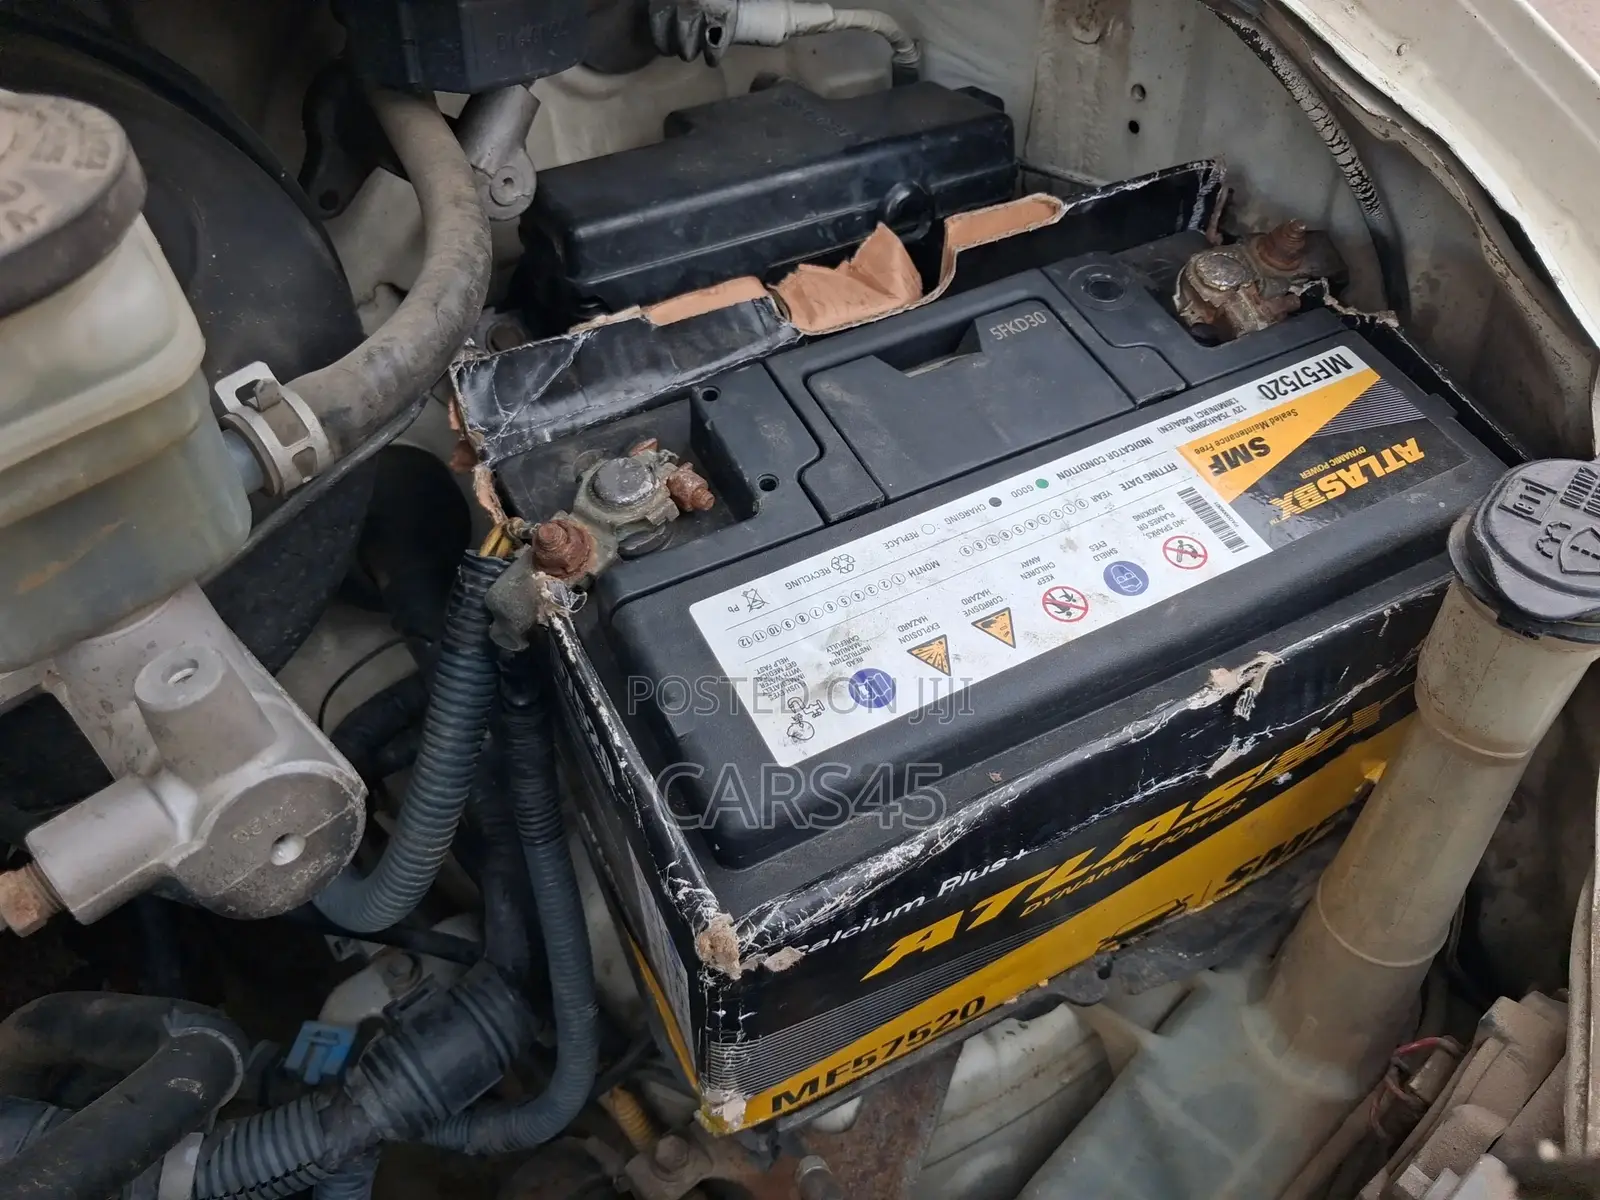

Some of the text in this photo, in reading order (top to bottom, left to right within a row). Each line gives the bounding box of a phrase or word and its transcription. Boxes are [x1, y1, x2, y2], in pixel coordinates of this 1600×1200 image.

[989, 311, 1047, 340] 5FKD30
[1253, 352, 1354, 401] MF57520
[1183, 404, 1248, 433] 12V 75AH(20HR)
[1192, 396, 1240, 419] 130MIN(RC)
[1193, 407, 1298, 455] Sealed Maintenance Free
[1055, 435, 1154, 480] INDICATOR CONDITION
[1204, 435, 1271, 476] SMF
[1298, 445, 1366, 479] DYNAMIC POWER
[1117, 461, 1179, 491] FITTING DATE
[1009, 483, 1035, 498] GOOD
[1089, 489, 1112, 502] YEAR
[942, 502, 987, 525] CHARGING
[1131, 503, 1166, 521] SMOKING
[1135, 510, 1176, 531] FLAMES OR
[881, 529, 919, 549] REPLACE
[1141, 518, 1185, 540] NO SPARKS,
[1087, 539, 1108, 552] EYES
[1091, 547, 1119, 562] SHIELD
[906, 559, 941, 578] MONTH
[1018, 555, 1042, 568] AWAY
[1018, 560, 1056, 580] CHILDREN
[783, 565, 831, 590] RECYCLING
[1034, 573, 1055, 586] KEEP
[959, 588, 991, 605] HAZARD
[961, 594, 1004, 617] CORROSIVE
[726, 603, 739, 614] Pb
[895, 614, 929, 632] HAZARD
[897, 621, 941, 644] EXPLOSION
[824, 634, 860, 653] CAREFULLY
[831, 641, 861, 658] MANUAL
[771, 655, 789, 667] HELP
[828, 644, 872, 666] INSTRUCTION
[844, 655, 864, 667] READ
[752, 660, 797, 683] GET MEDICAL
[758, 666, 801, 688] WITH WATER
[1019, 797, 1247, 918] DYNAMIC POWER
[771, 995, 986, 1113] MF57520
